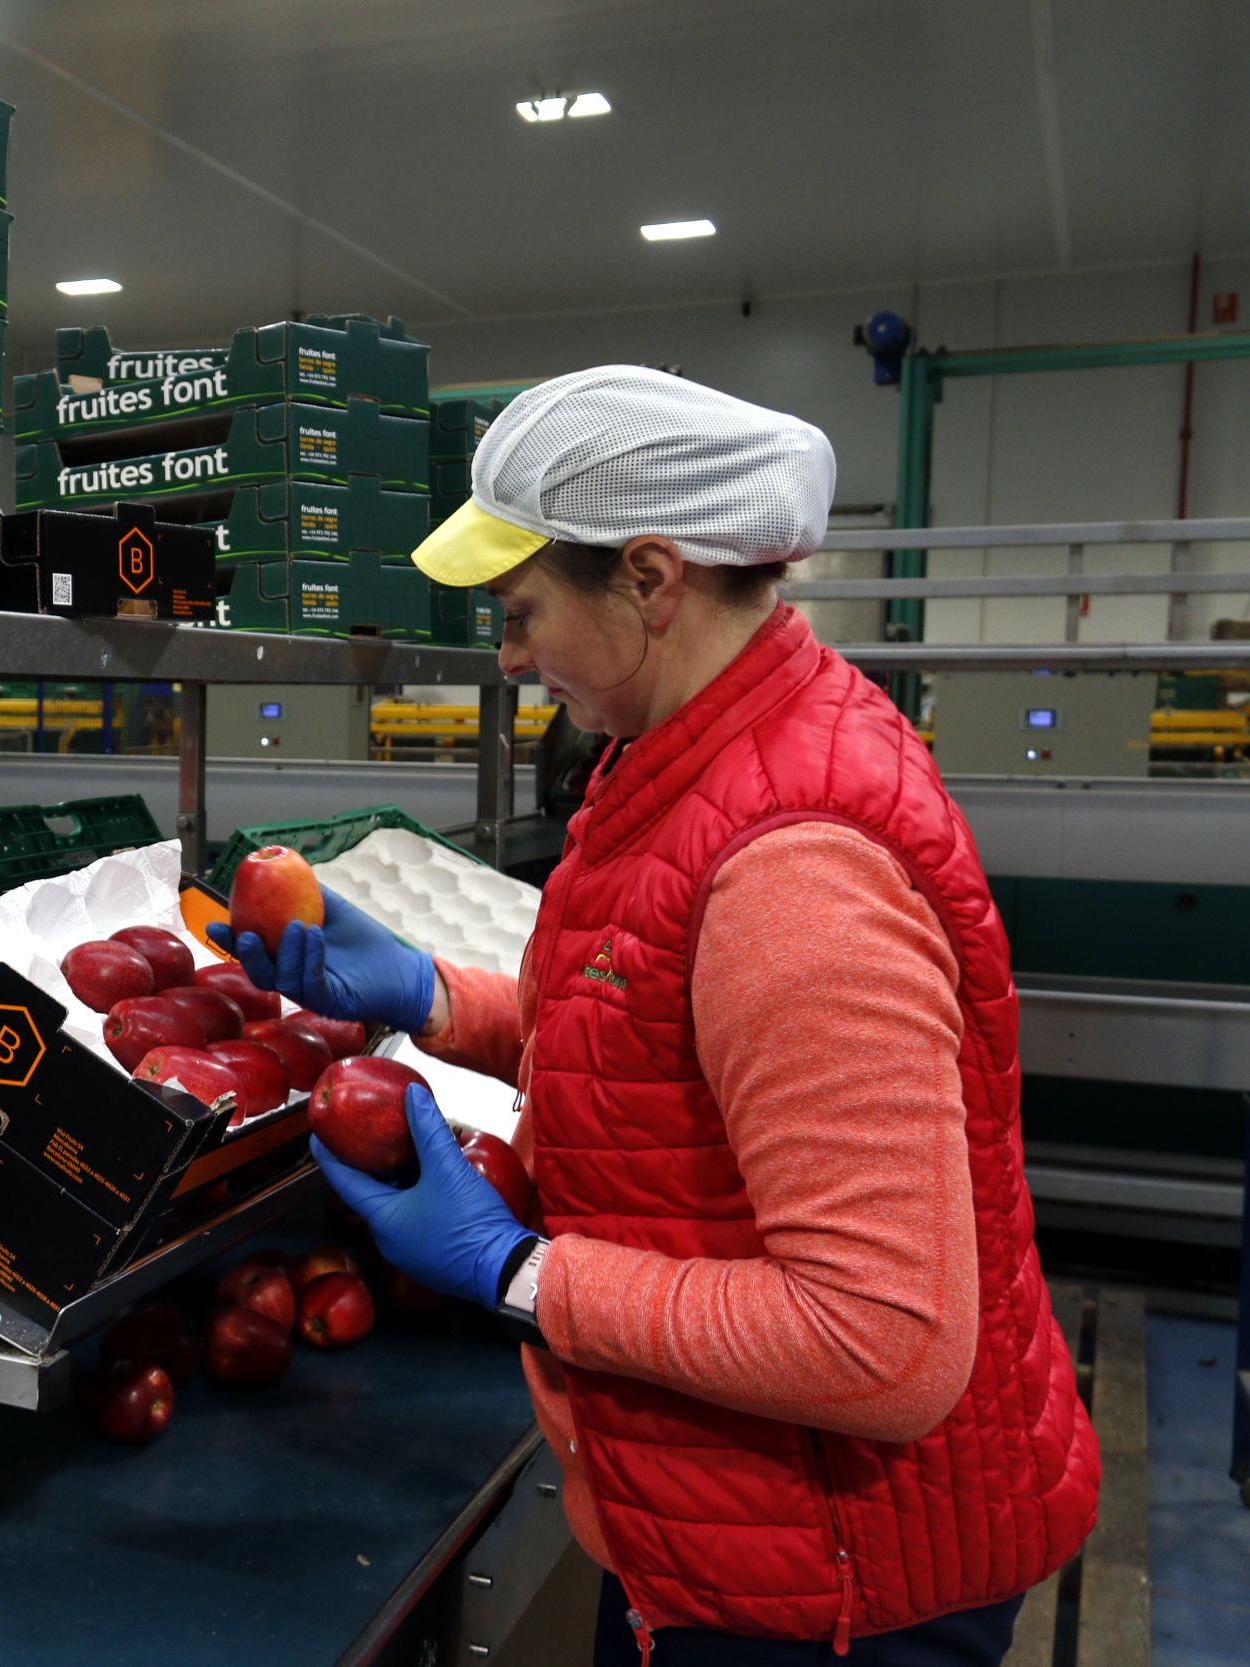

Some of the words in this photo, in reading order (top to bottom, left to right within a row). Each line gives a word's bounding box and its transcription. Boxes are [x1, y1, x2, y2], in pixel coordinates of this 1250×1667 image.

[299, 348, 321, 358] fruites
[322, 351, 336, 360] font
[107, 353, 214, 379] fruites
[56, 389, 153, 424] fruites
[161, 370, 228, 405] font
[300, 427, 321, 436] fruites
[323, 430, 336, 438] font
[57, 462, 153, 495] fruites
[162, 448, 228, 481] font
[301, 505, 323, 514] fruites
[324, 507, 337, 515] font
[131, 548, 143, 573] B
[302, 583, 324, 591] fruites
